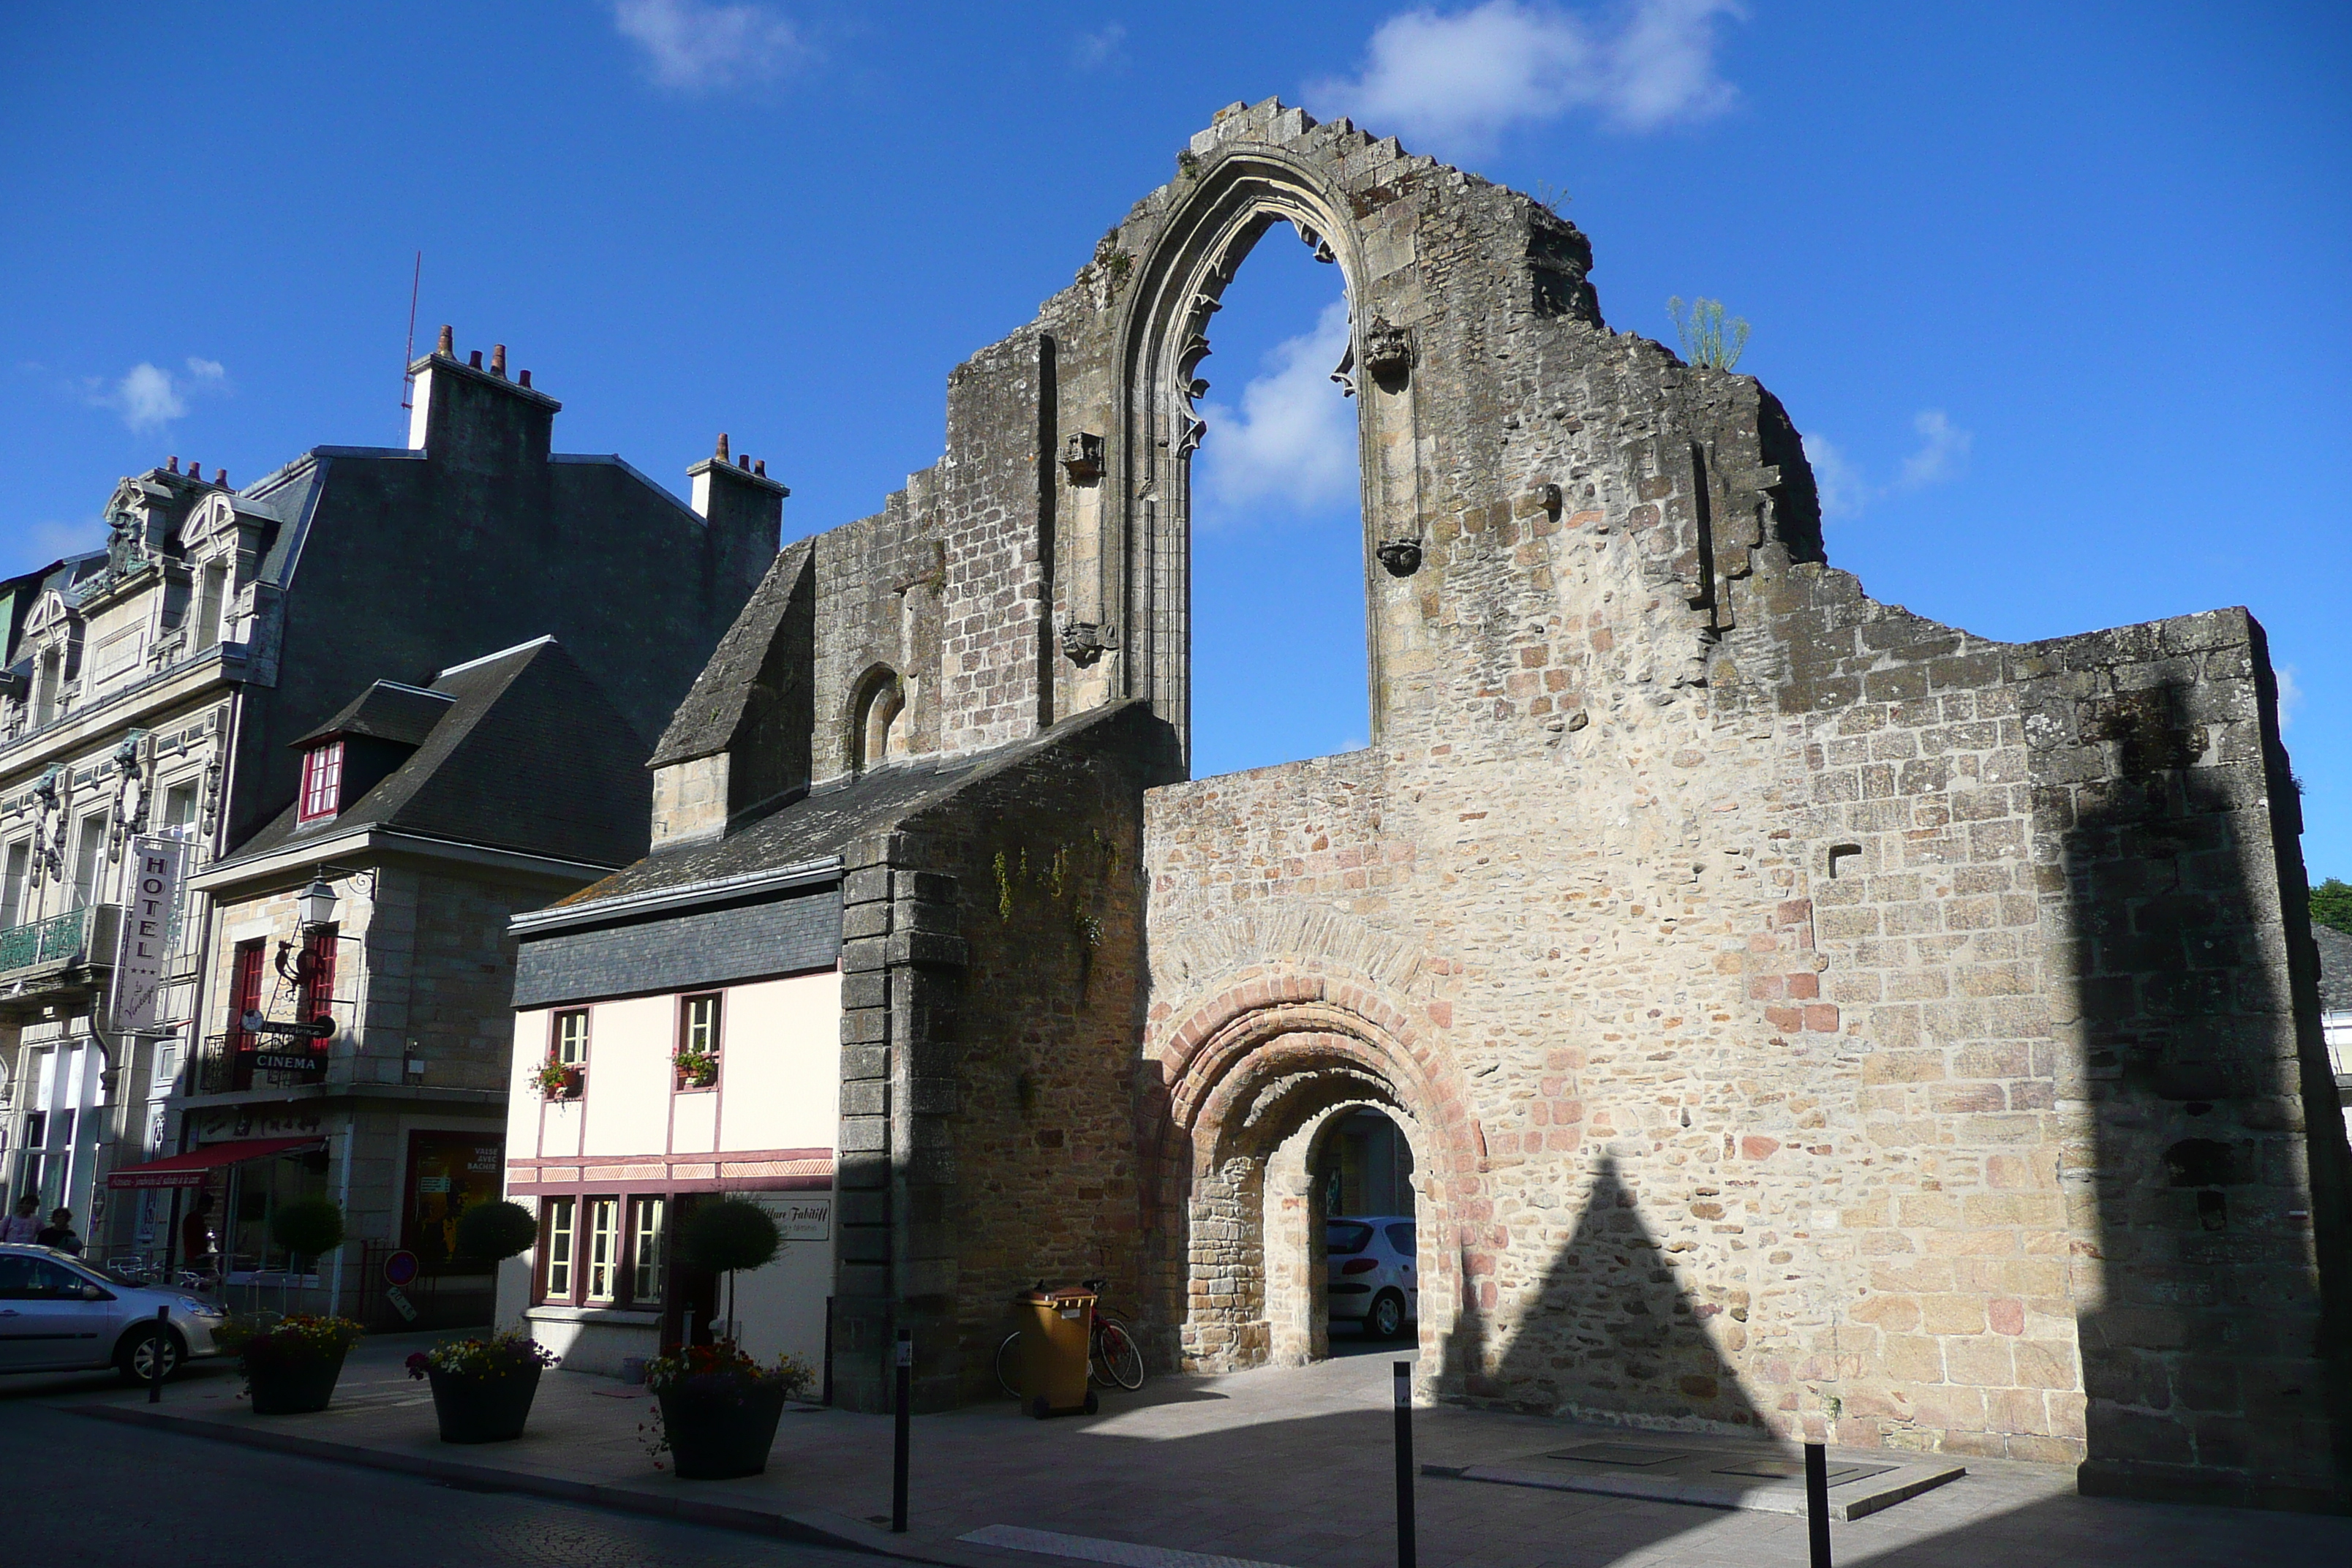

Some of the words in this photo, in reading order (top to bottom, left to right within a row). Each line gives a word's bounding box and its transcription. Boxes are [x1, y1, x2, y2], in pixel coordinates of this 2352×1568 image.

[137, 856, 167, 960] HOTEL
[256, 1055, 316, 1070] CINEMA
[474, 1147, 498, 1156] VALSE
[467, 1162, 497, 1170] BACHIR
[789, 1207, 828, 1222] Fabitiff
